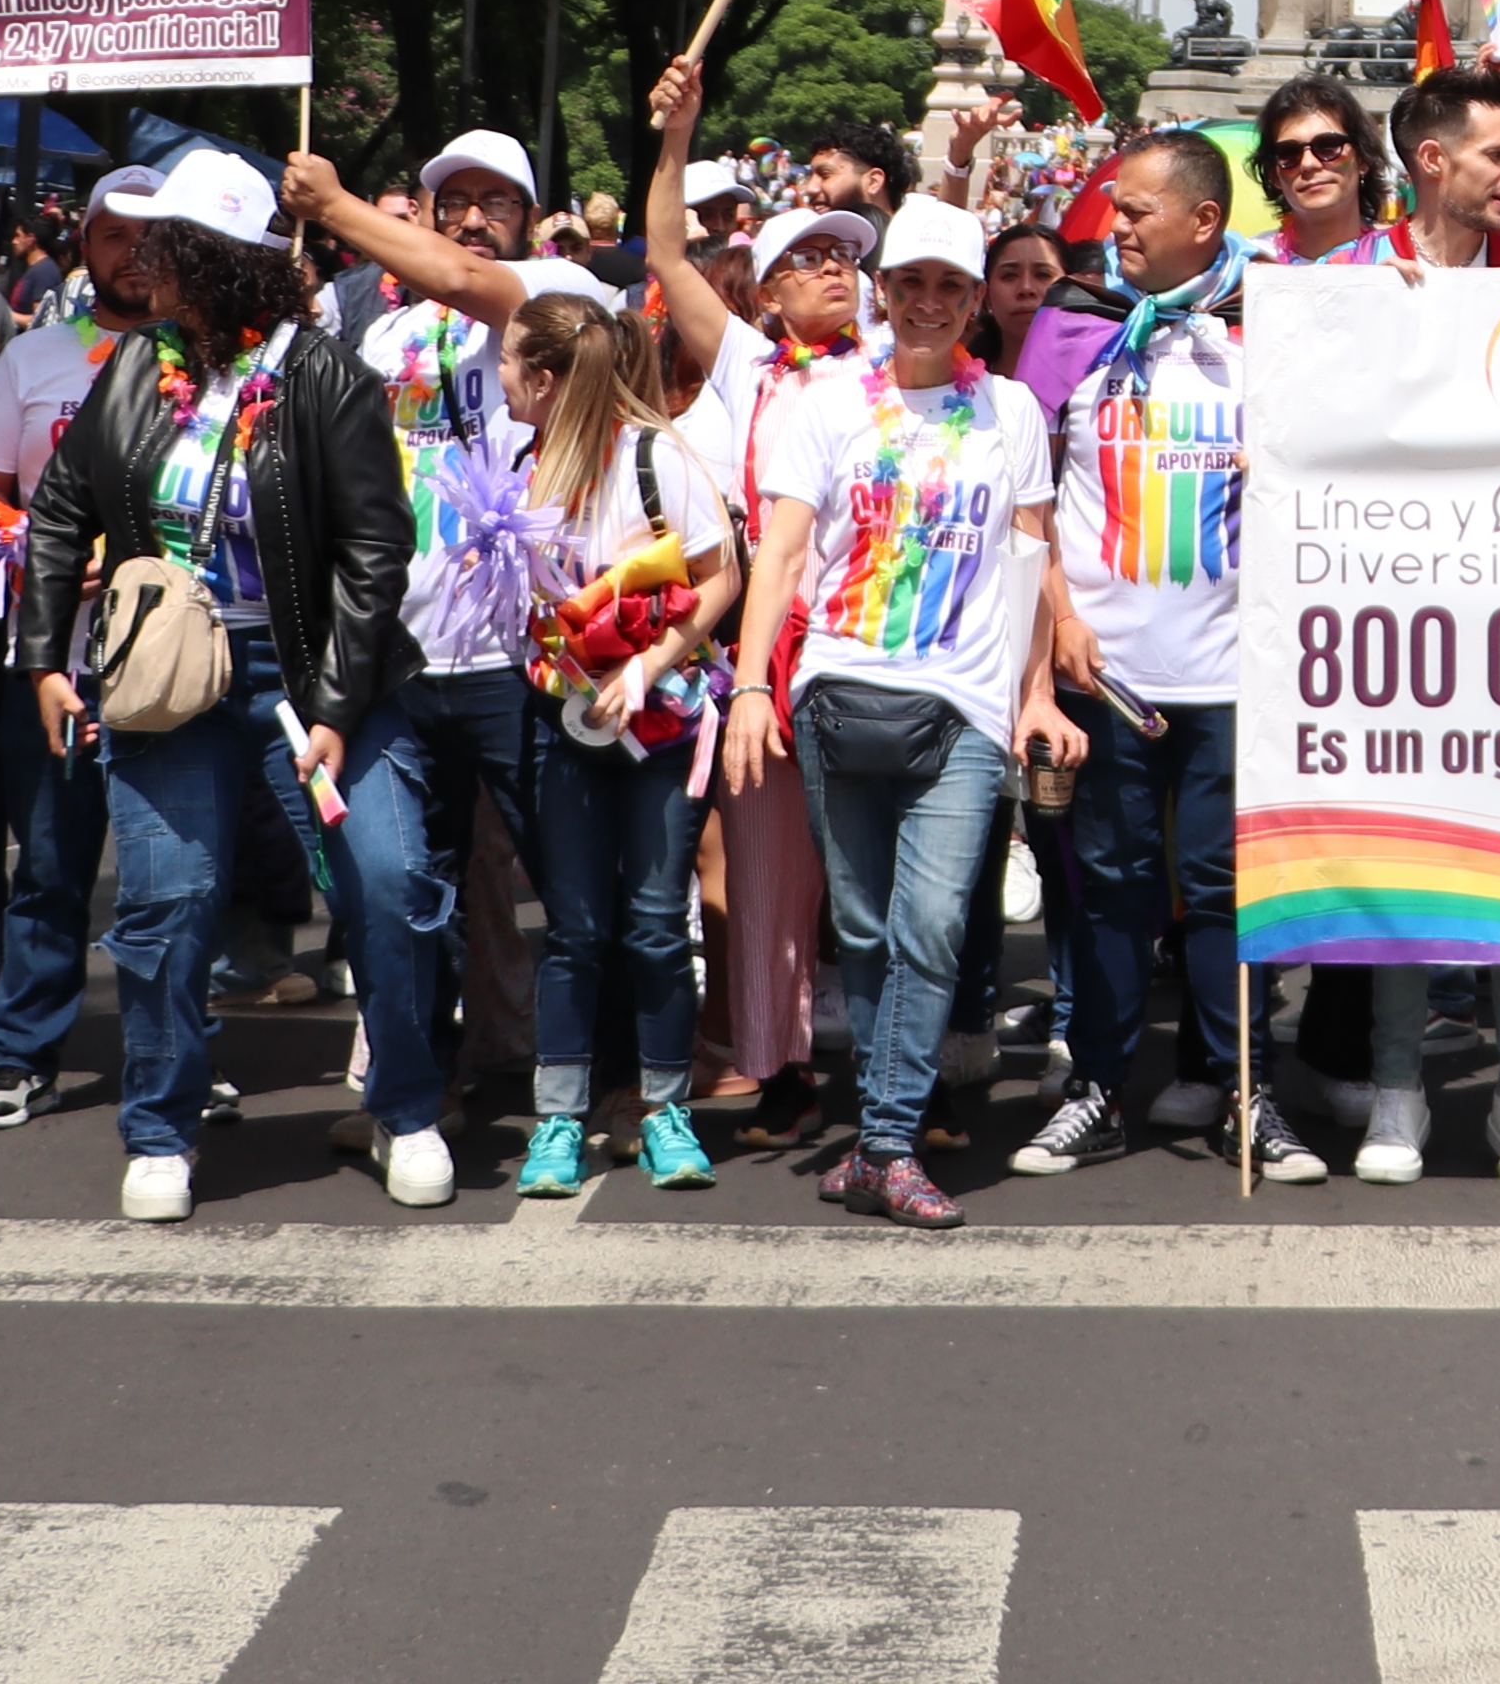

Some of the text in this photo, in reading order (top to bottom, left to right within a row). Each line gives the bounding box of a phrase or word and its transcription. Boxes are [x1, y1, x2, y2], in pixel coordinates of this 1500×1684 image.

[69, 23, 94, 60] y
[94, 10, 281, 55] confidencial!
[1106, 378, 1125, 397] ES
[854, 461, 873, 480] ES
[1295, 483, 1431, 532] Línea
[1451, 499, 1476, 542] y
[1298, 604, 1457, 708] 800
[1297, 722, 1348, 775] Es
[1365, 730, 1423, 775] un
